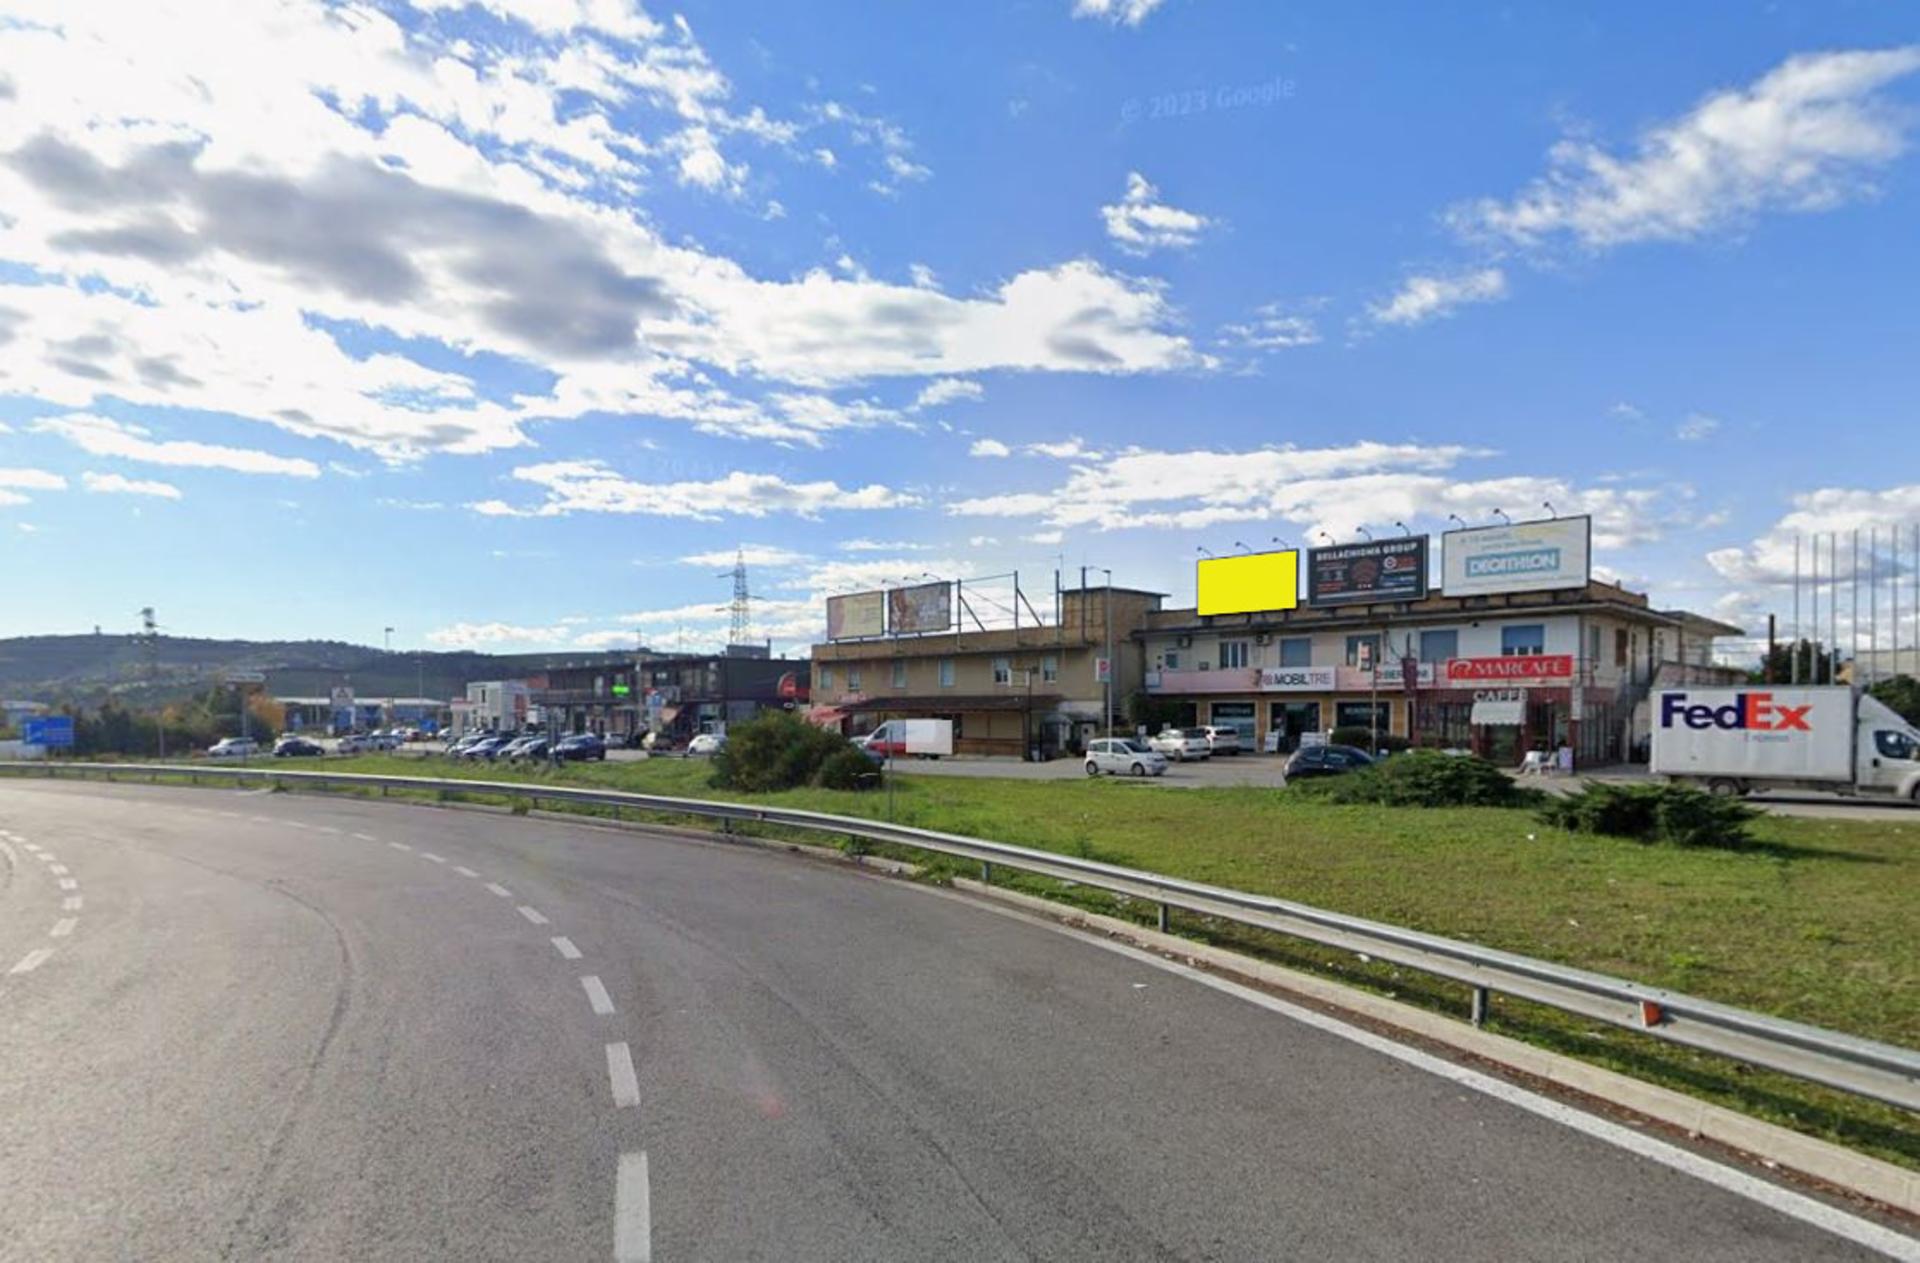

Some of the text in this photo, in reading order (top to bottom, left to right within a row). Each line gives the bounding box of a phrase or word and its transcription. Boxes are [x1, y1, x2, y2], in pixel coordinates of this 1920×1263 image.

[1383, 542, 1417, 554] GROUP
[1470, 552, 1556, 573] DECATHLON
[1661, 693, 1814, 732] FedEx
